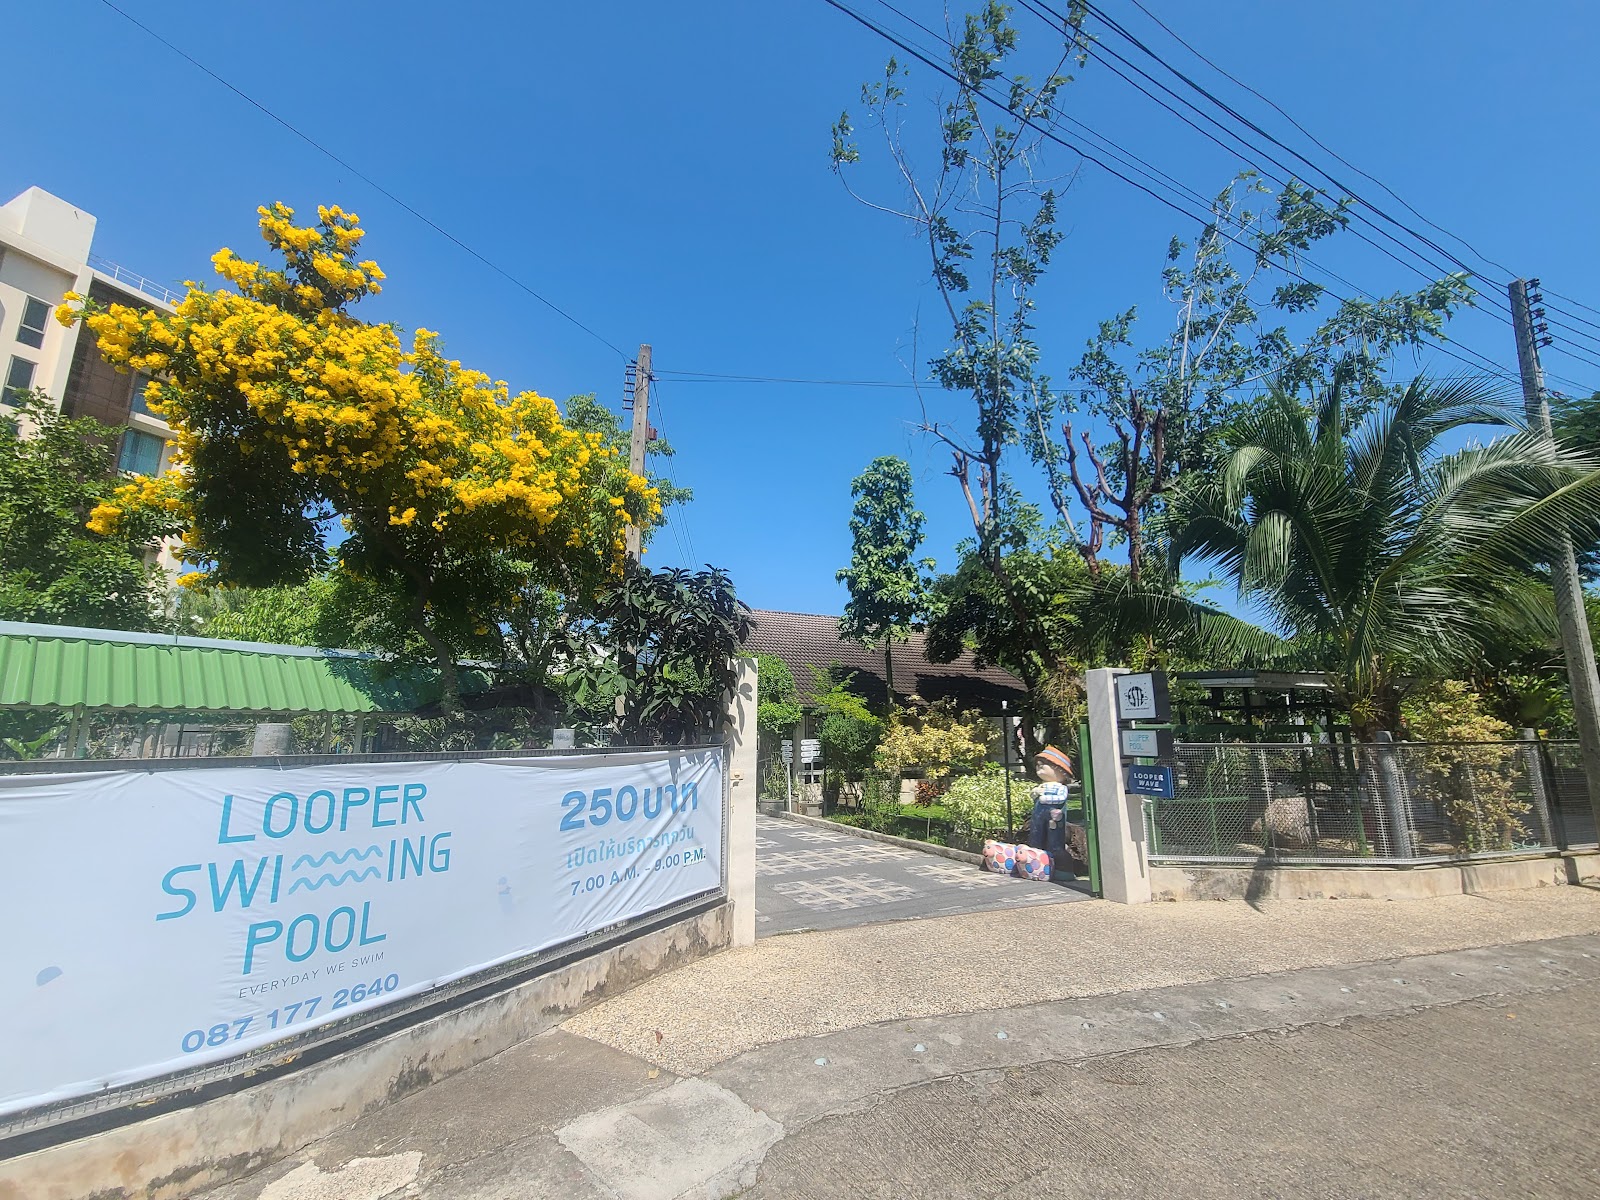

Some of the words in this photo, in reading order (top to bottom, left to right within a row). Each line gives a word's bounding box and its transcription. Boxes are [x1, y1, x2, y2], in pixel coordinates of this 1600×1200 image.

[1133, 772, 1164, 781] LOOPER
[1138, 780, 1159, 788] WAVE
[218, 783, 427, 844] LOOPER
[571, 874, 605, 896] 7.00
[609, 866, 640, 886] A.M.
[683, 847, 706, 864] P.M.
[242, 901, 387, 975] POOL
[239, 968, 320, 999] EVERYDAY
[326, 961, 346, 975] WE
[351, 951, 385, 968] SWIM
[181, 1016, 253, 1053] 087
[267, 996, 322, 1030] 177
[331, 973, 399, 1010] 2640
